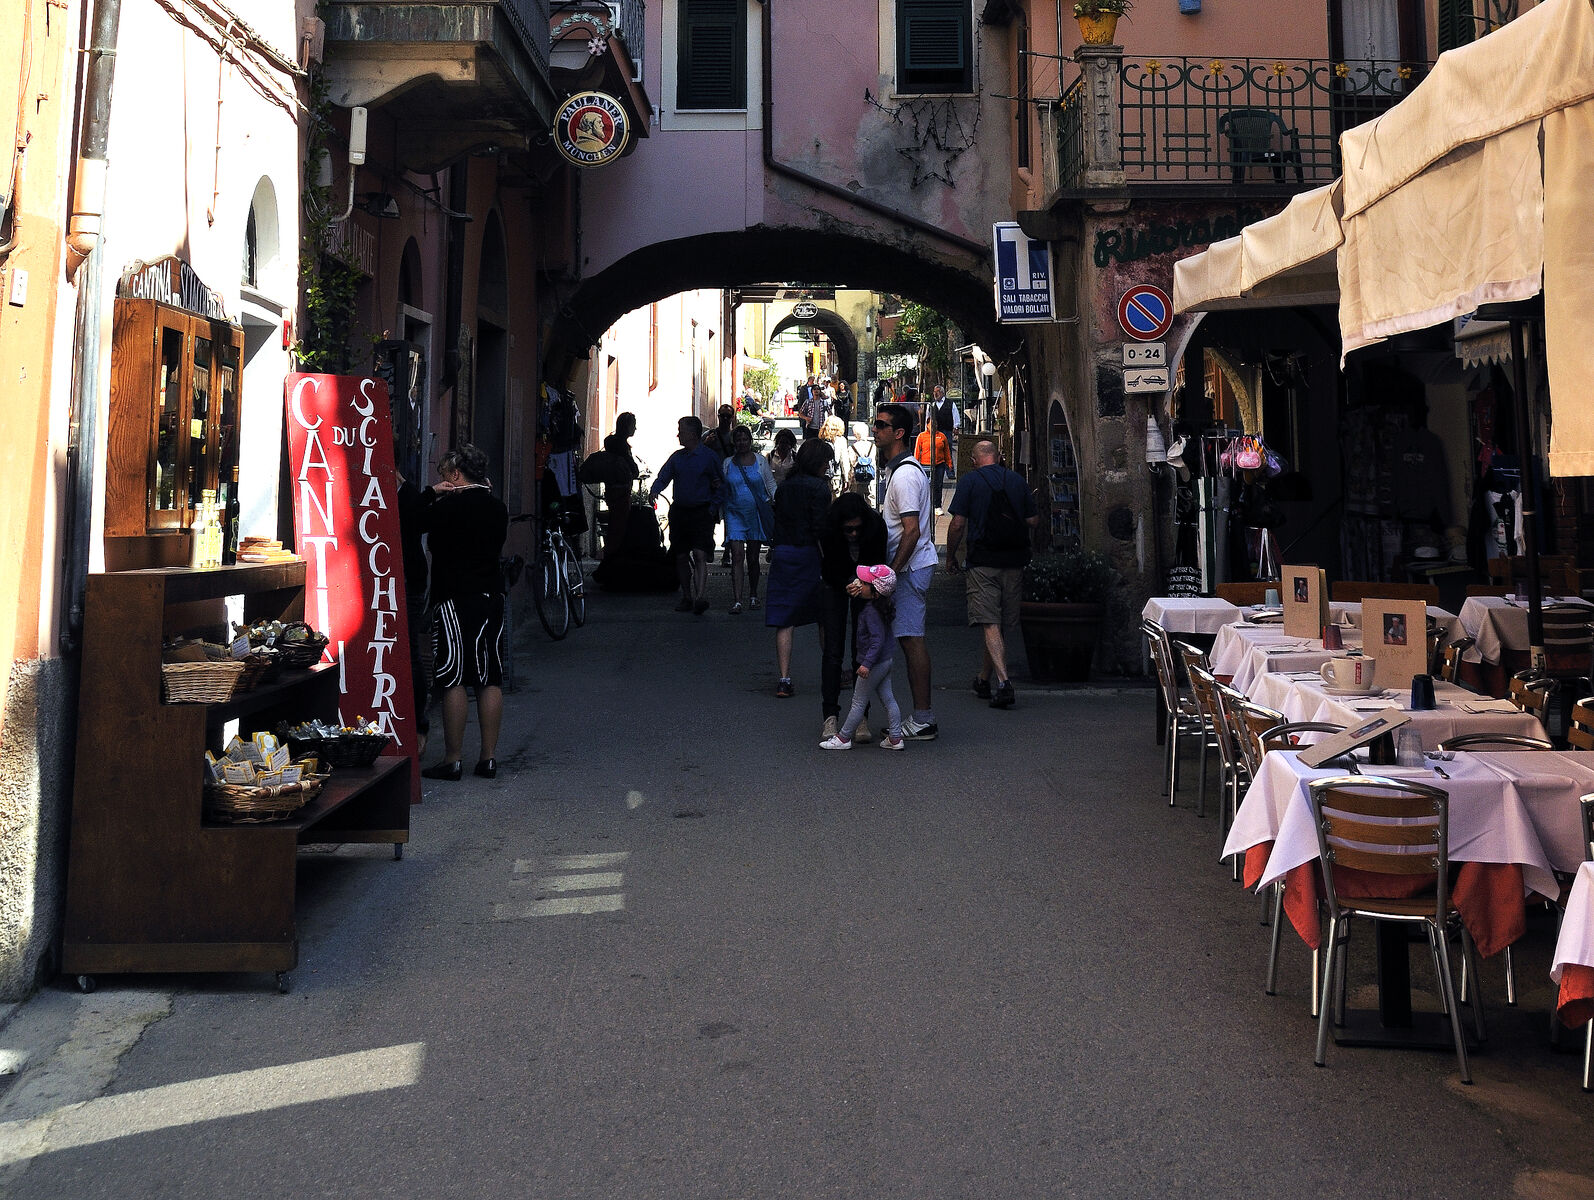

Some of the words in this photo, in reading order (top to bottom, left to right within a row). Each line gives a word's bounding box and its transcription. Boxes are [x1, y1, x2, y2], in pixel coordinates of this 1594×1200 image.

[561, 96, 623, 126] PAULANER
[132, 259, 172, 306] CANTINA
[1002, 294, 1016, 303] SALI
[1018, 293, 1048, 303] TABACCHI
[1002, 304, 1024, 314] VALORI
[1025, 304, 1049, 313] BOLLATI
[332, 426, 356, 447] DU
[291, 376, 347, 727] CANTI
[350, 378, 405, 746] SCIACCHETRA
